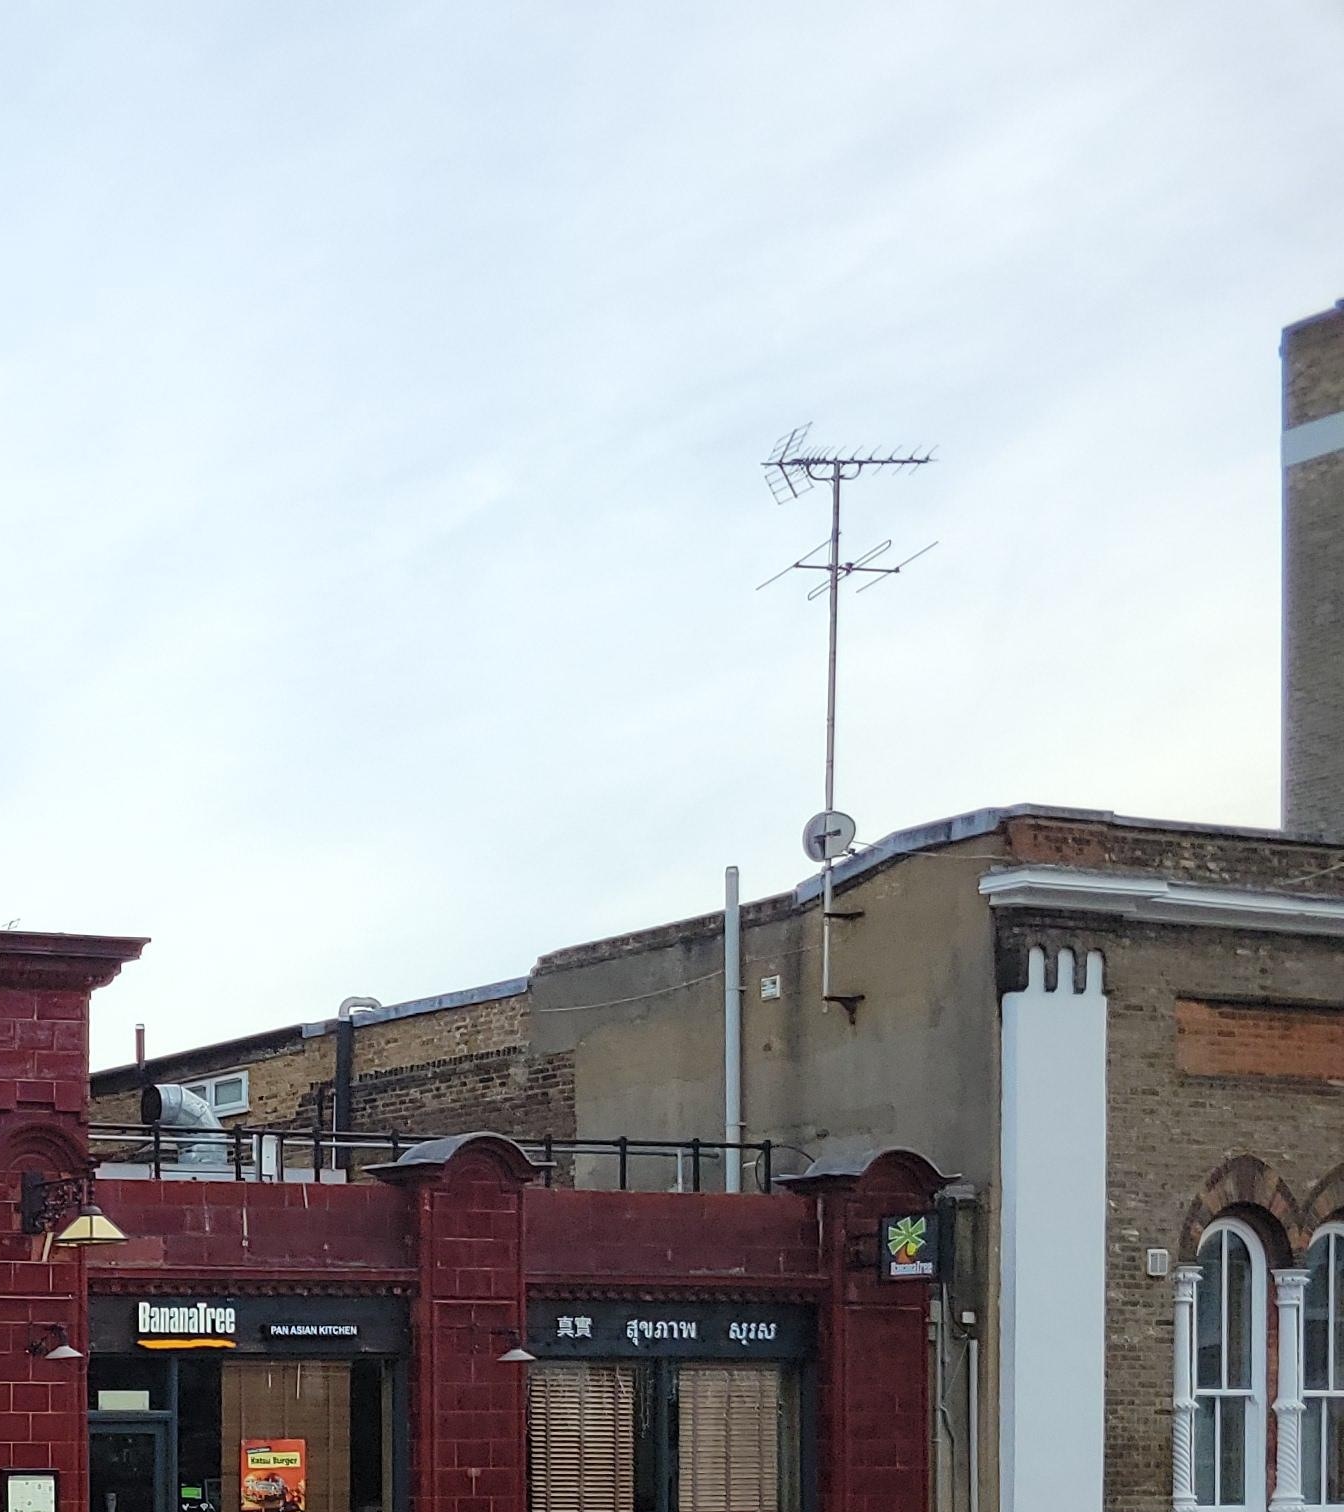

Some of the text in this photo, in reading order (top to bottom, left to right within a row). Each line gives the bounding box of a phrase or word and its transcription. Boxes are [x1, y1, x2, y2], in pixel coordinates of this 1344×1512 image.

[138, 1302, 236, 1333] BananaTree
[270, 1325, 358, 1336] PAN ASIAN KITCHEN
[626, 1319, 697, 1346] สุขภาพ
